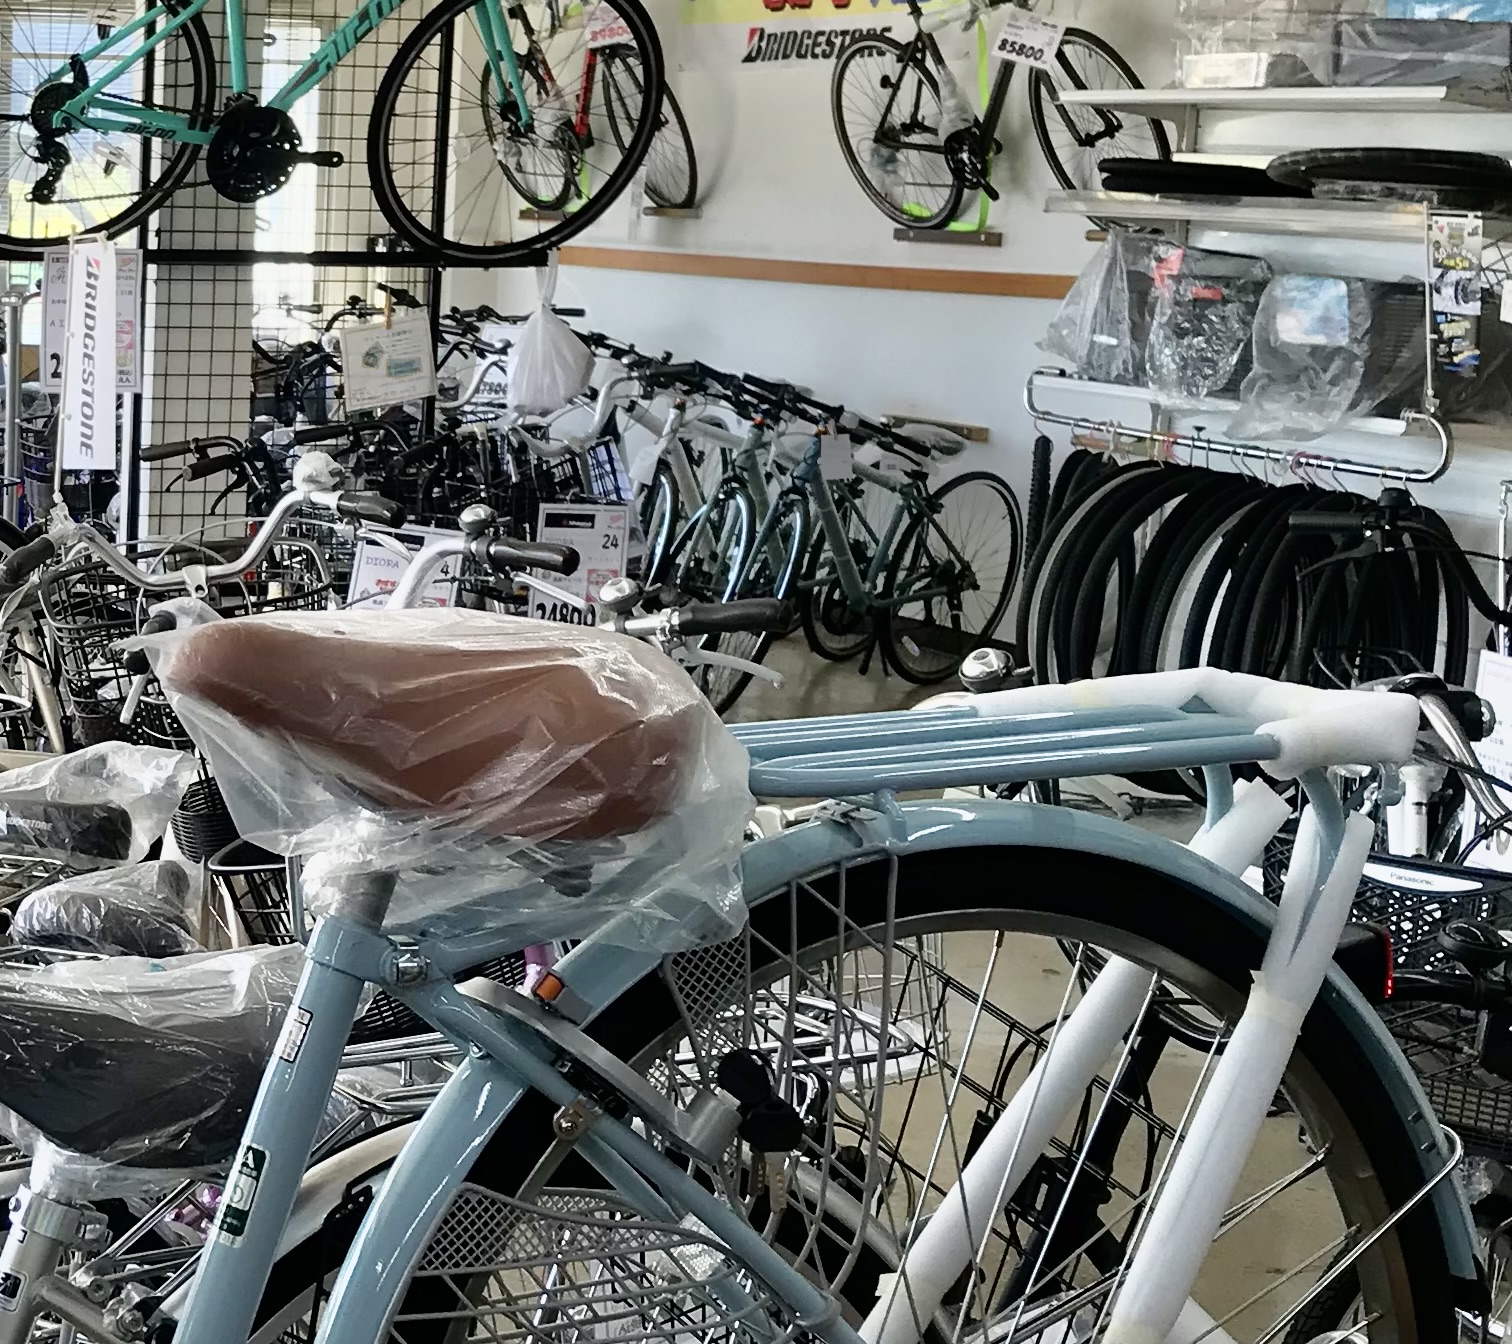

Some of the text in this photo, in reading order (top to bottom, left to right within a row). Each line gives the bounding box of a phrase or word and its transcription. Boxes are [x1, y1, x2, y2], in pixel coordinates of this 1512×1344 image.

[998, 38, 1044, 61] 85800
[80, 256, 101, 459] BRIDGESTONE
[601, 534, 619, 550] 24
